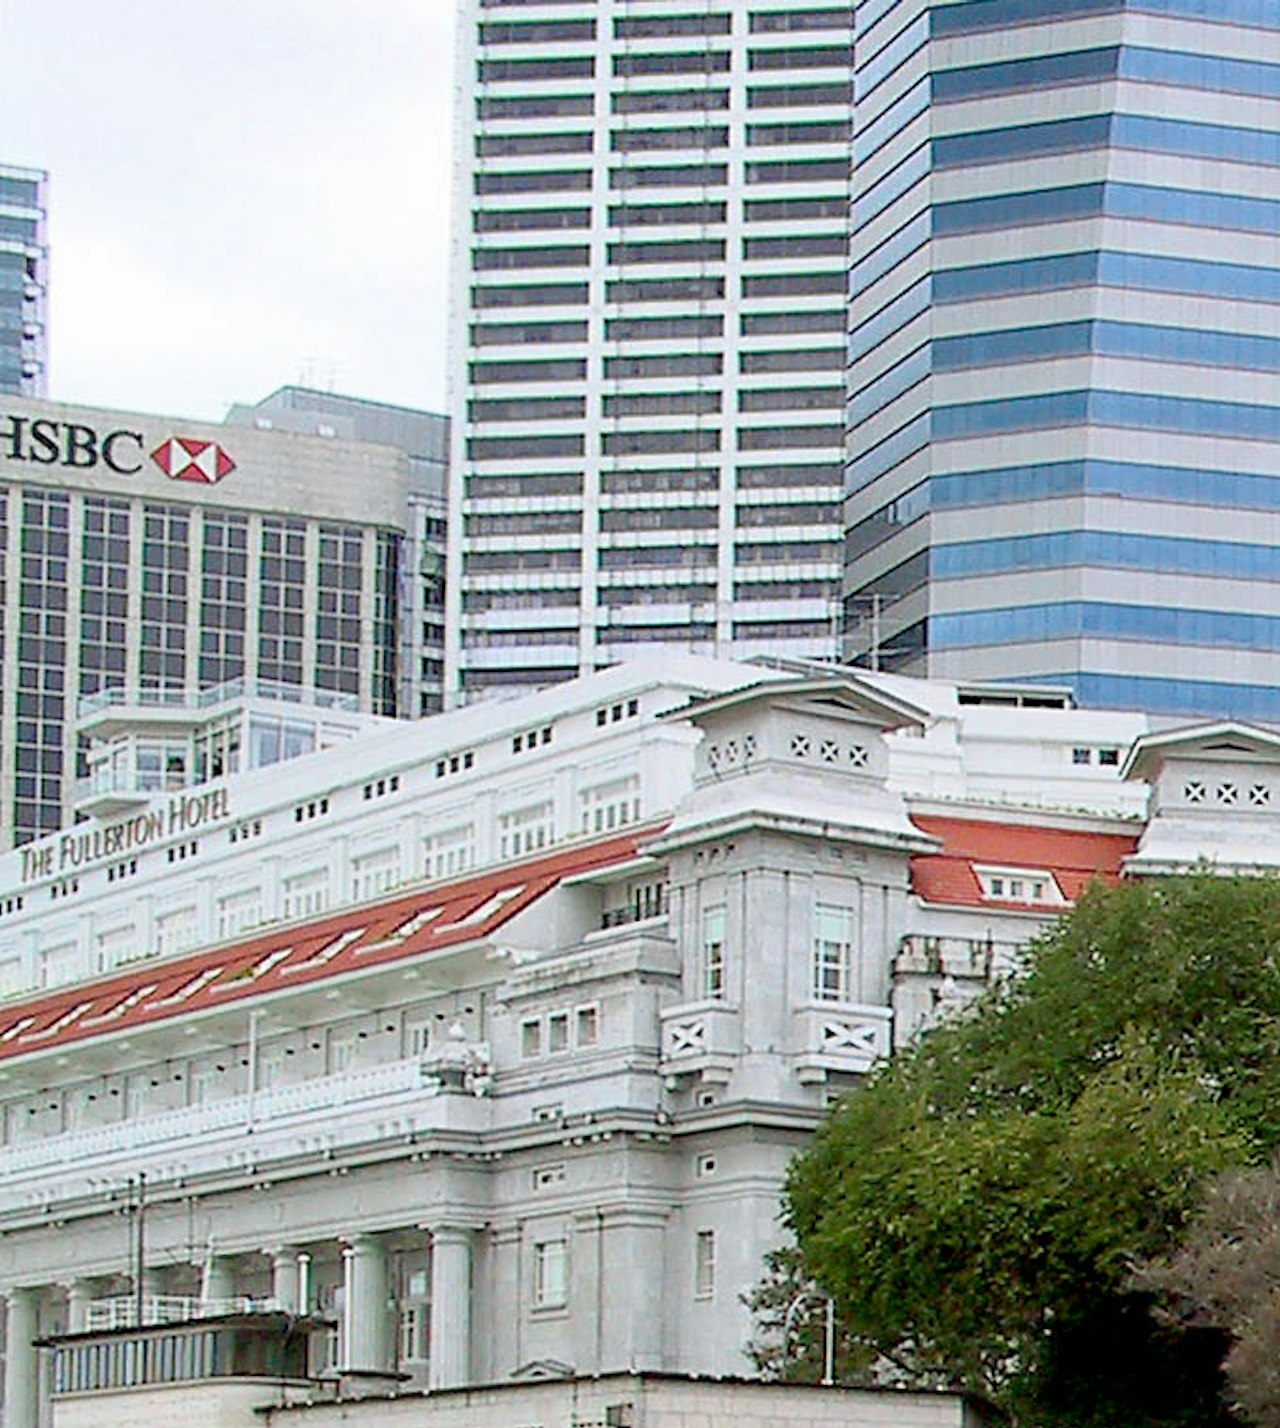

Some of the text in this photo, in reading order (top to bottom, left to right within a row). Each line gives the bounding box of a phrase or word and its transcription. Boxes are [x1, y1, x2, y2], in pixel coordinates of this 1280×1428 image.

[0, 415, 144, 475] HSBC
[20, 787, 231, 882] THE FULLERTON HOTEL
